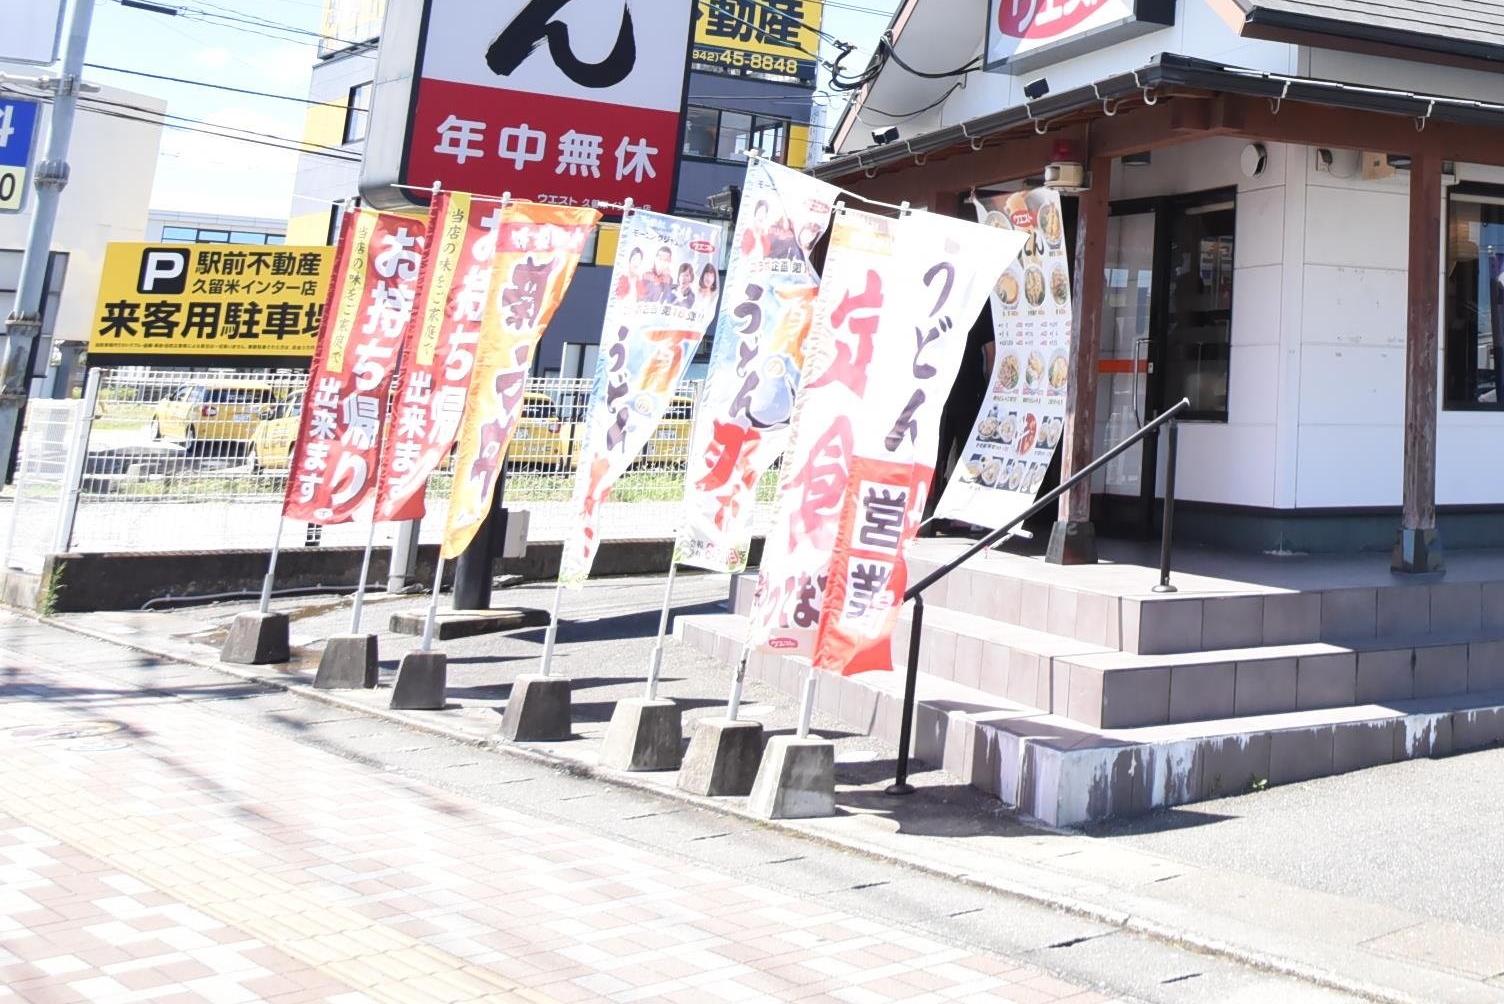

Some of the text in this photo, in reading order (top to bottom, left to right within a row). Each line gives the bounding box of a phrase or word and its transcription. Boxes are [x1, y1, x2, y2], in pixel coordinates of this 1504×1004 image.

[433, 114, 660, 184] 年中無休
[537, 193, 578, 206] ウエスト
[142, 251, 185, 291] P
[192, 278, 318, 296] 久留米インター店
[195, 250, 322, 276] 駅前不動産
[331, 226, 368, 365] 当店の味をご家庭で
[422, 208, 466, 356] 当店の味をご家庭で
[331, 227, 424, 506] お持ち帰り
[884, 236, 962, 453] うどん
[298, 377, 342, 504] 出来ます
